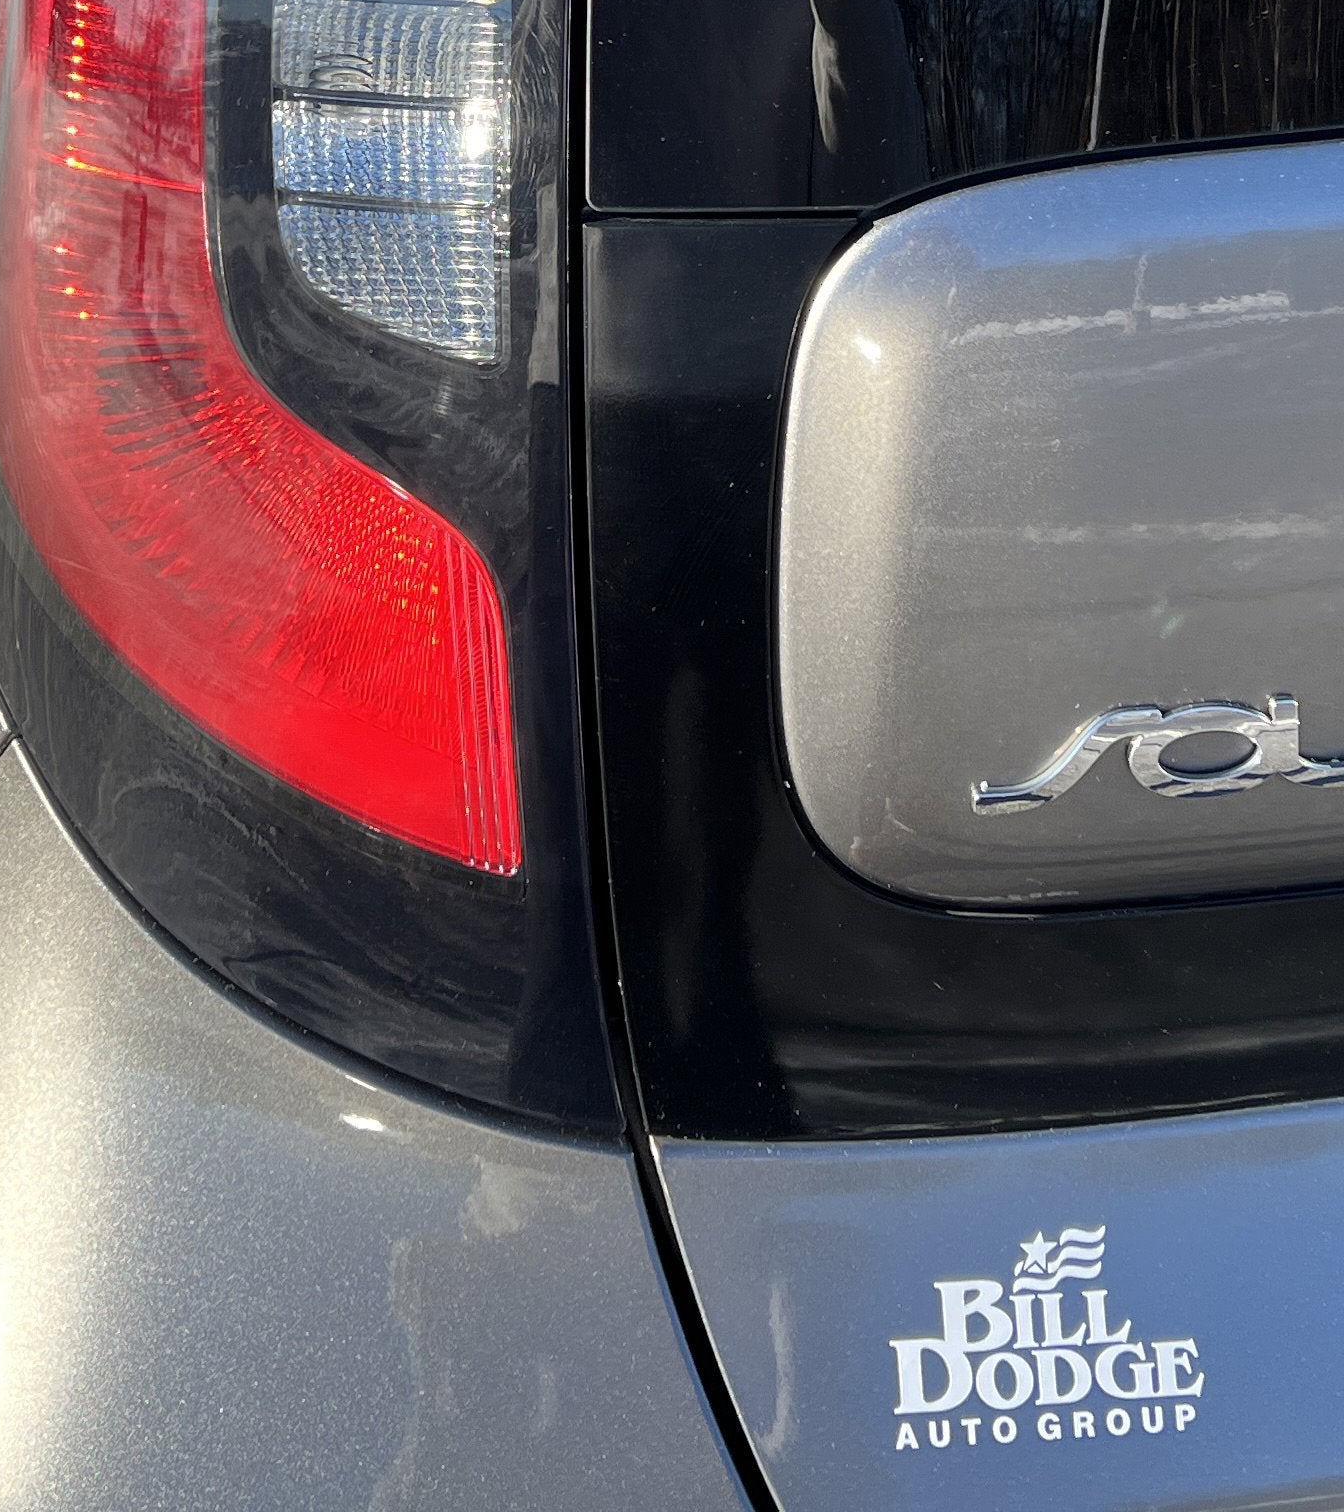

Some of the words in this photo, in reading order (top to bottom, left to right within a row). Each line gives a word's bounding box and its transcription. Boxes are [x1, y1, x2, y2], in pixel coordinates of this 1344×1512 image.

[933, 1279, 1132, 1352] BILL
[889, 1337, 1205, 1416] DODGE
[895, 1415, 1018, 1451] AUTO
[1036, 1403, 1197, 1442] GROUP
